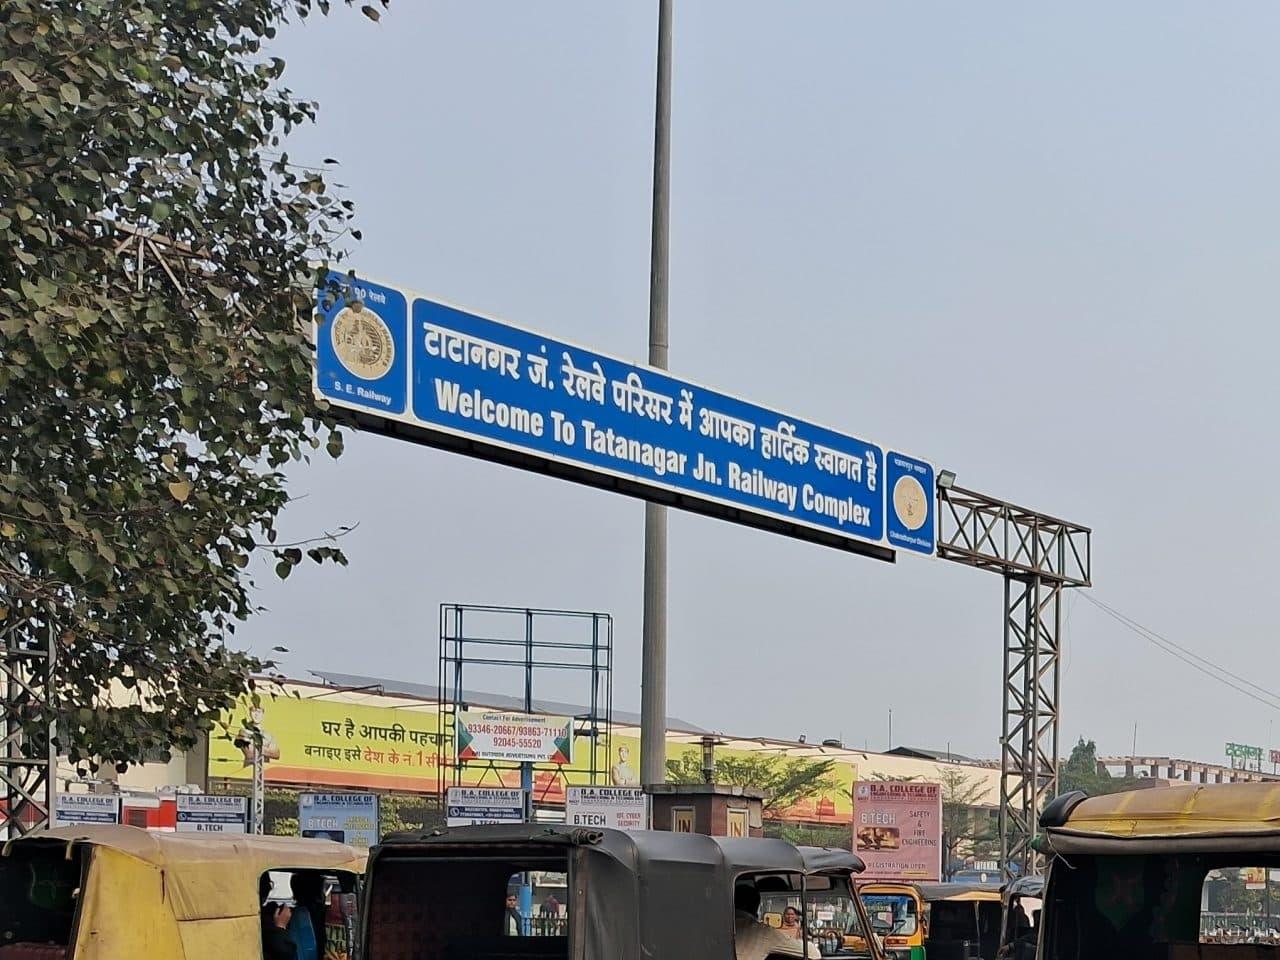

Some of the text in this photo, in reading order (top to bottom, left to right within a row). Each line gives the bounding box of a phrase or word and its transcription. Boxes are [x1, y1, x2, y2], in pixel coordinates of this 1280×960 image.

[346, 384, 355, 394] E.
[357, 387, 391, 405] Railway
[423, 322, 521, 380] टाटानगर
[527, 344, 554, 390] जं.
[562, 352, 606, 405] रेलवे
[612, 372, 673, 425] परिसर
[679, 389, 694, 431] में
[699, 408, 756, 450] आपका
[760, 421, 810, 465] हार्दिक
[814, 444, 862, 483] स्वागत
[865, 450, 877, 491] है
[434, 378, 871, 527] Welcome To Tatanagar Jn. Railway Complex
[322, 718, 454, 748] घर है आपकी पहचान
[344, 745, 361, 762] इसे
[364, 746, 384, 763] देश
[388, 749, 400, 765] के
[417, 750, 423, 767] 1
[574, 815, 606, 825] B.TECH
[910, 810, 930, 818] SAFETY
